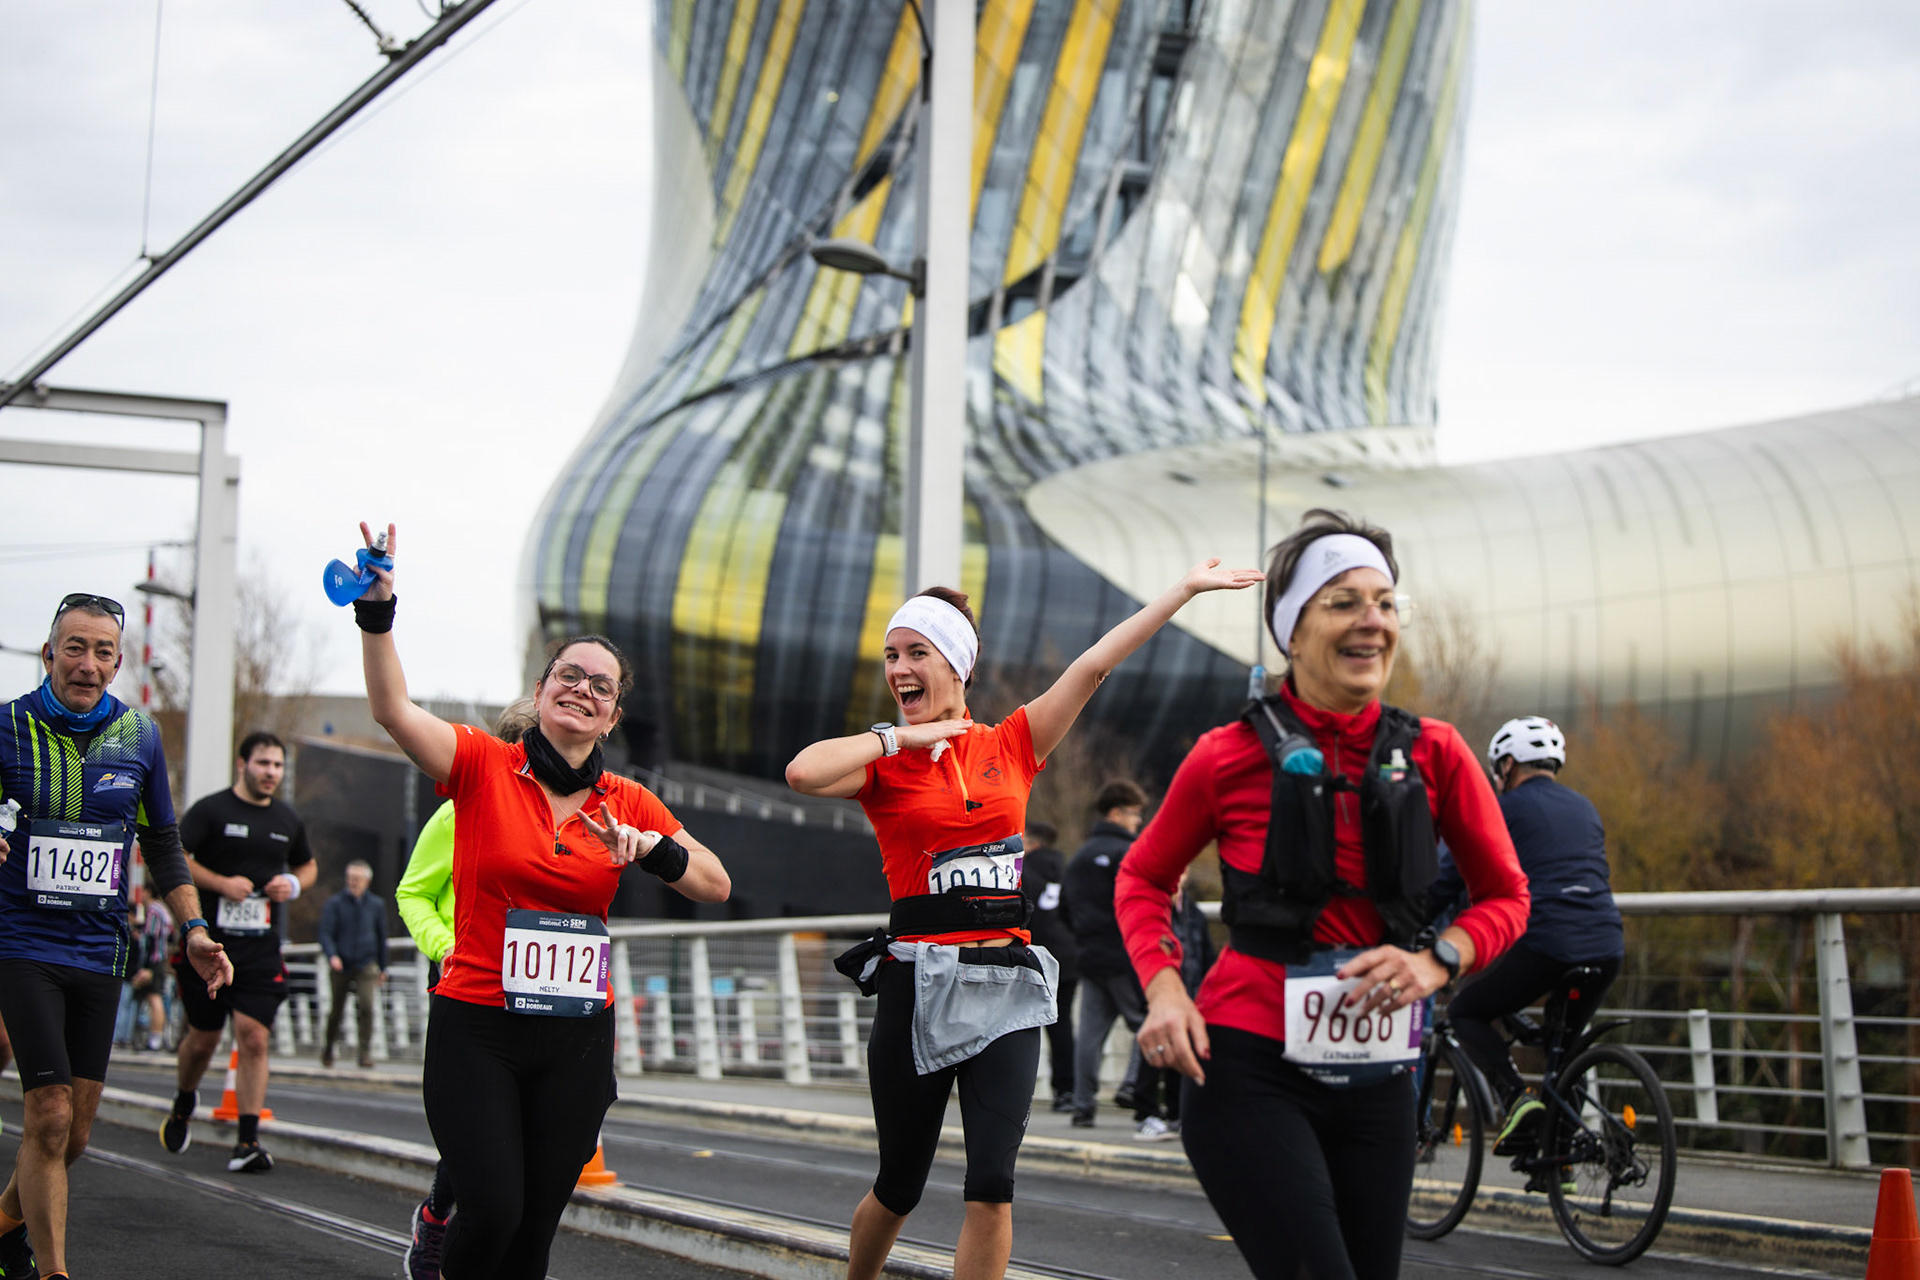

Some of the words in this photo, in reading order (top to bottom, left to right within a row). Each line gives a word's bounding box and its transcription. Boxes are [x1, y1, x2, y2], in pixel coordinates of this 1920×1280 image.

[31, 846, 109, 883] 11482
[46, 899, 73, 907] BORDEAUX
[569, 918, 587, 928] SEMI
[507, 940, 595, 984] 10112
[526, 1002, 553, 1011] BORDEAUX
